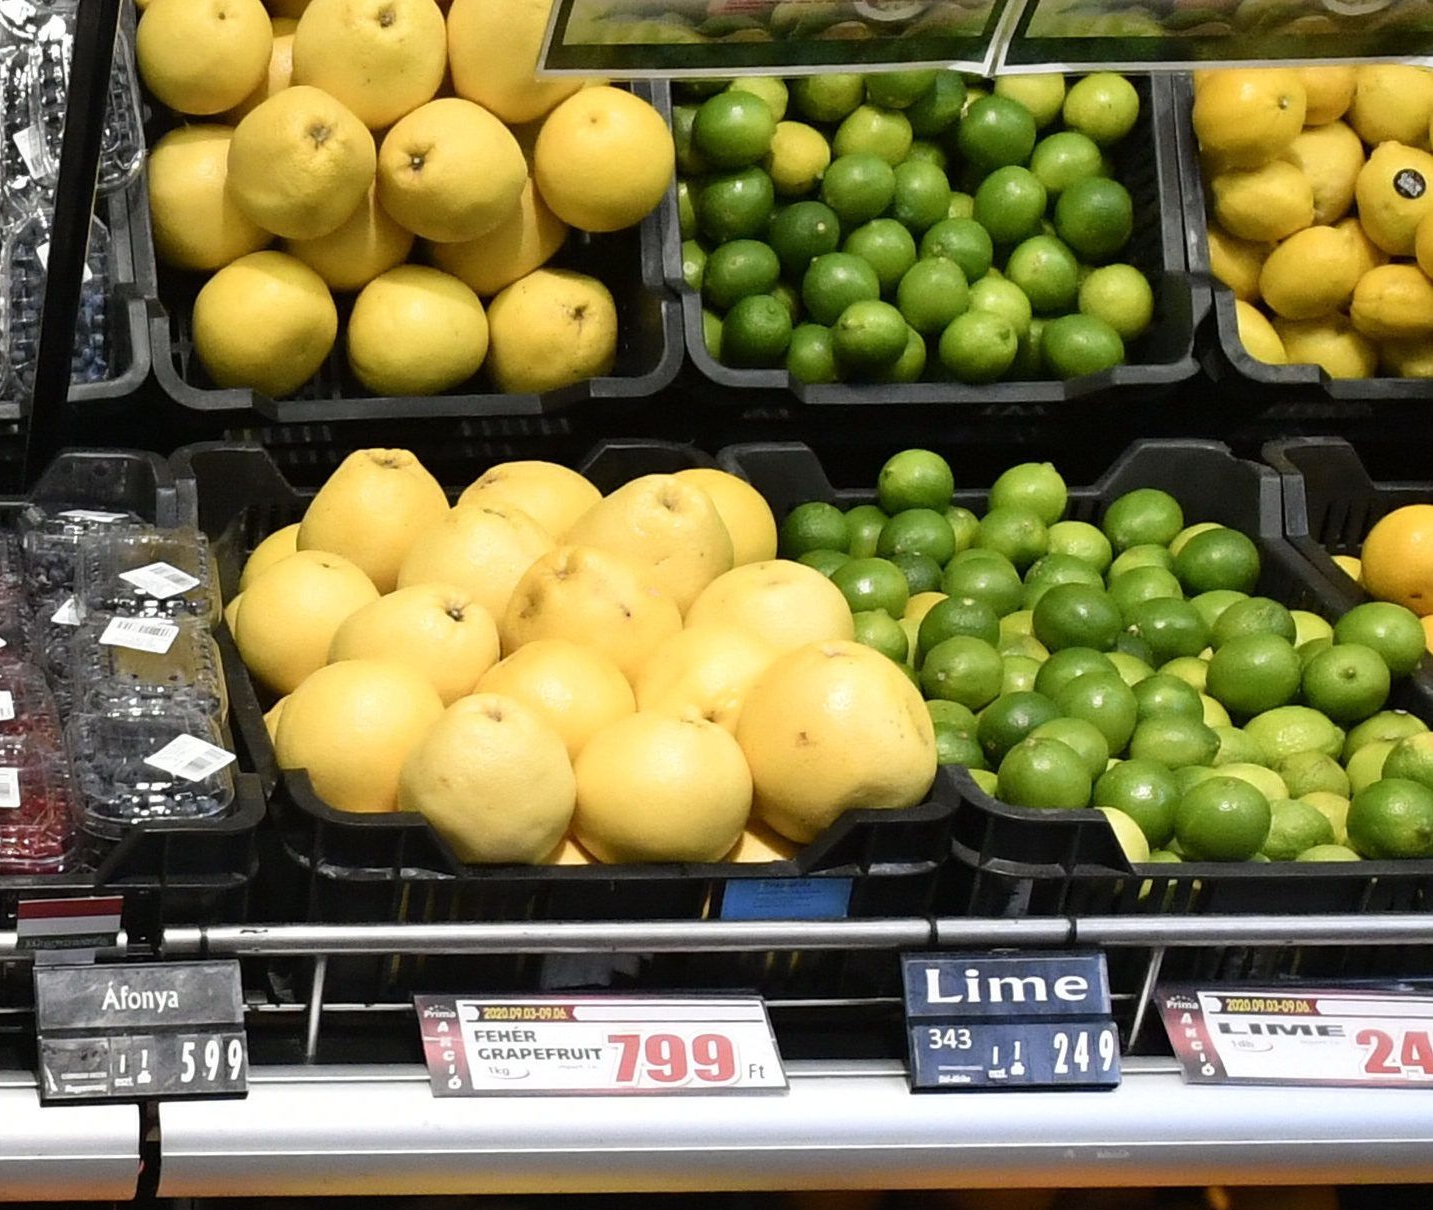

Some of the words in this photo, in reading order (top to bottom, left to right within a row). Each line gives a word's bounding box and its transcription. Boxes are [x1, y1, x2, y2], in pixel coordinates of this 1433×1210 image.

[925, 968, 1088, 1003] Lime
[101, 982, 179, 1013] Áfonya
[1166, 1000, 1199, 1010] Prima
[423, 1008, 456, 1018] Prima
[473, 1026, 537, 1043] FEHÉR
[928, 1029, 972, 1049] 343
[1217, 1022, 1346, 1037] LIME
[180, 1039, 243, 1083] 599
[477, 1047, 603, 1061] GRAPEFRUIT
[607, 1033, 736, 1083] 799
[748, 1064, 765, 1079] Ft
[1053, 1030, 1114, 1074] 249
[1355, 1029, 1433, 1075] 24
[488, 1066, 510, 1076] 1kg
